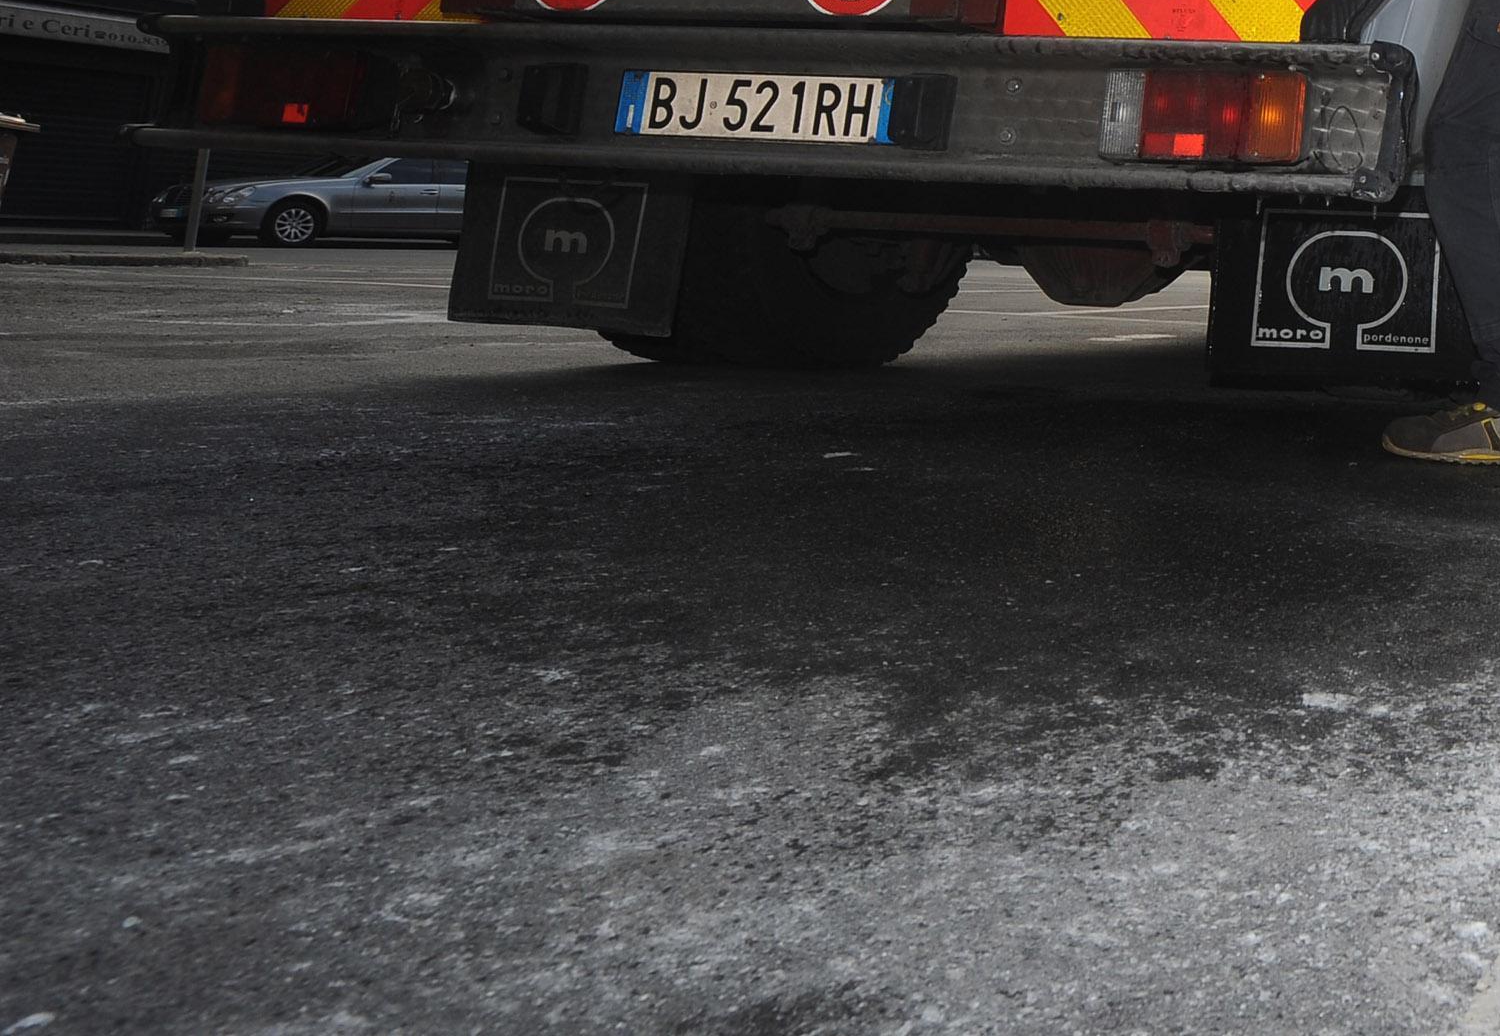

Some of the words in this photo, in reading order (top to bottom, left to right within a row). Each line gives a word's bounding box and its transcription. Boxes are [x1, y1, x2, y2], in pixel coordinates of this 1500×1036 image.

[22, 19, 35, 30] e
[41, 19, 91, 38] Ceri
[648, 76, 708, 131] BJ
[723, 78, 874, 138] 521RH
[493, 282, 548, 295] moro
[1318, 266, 1375, 294] m
[1256, 326, 1323, 341] moro
[1362, 332, 1430, 346] pordenone
